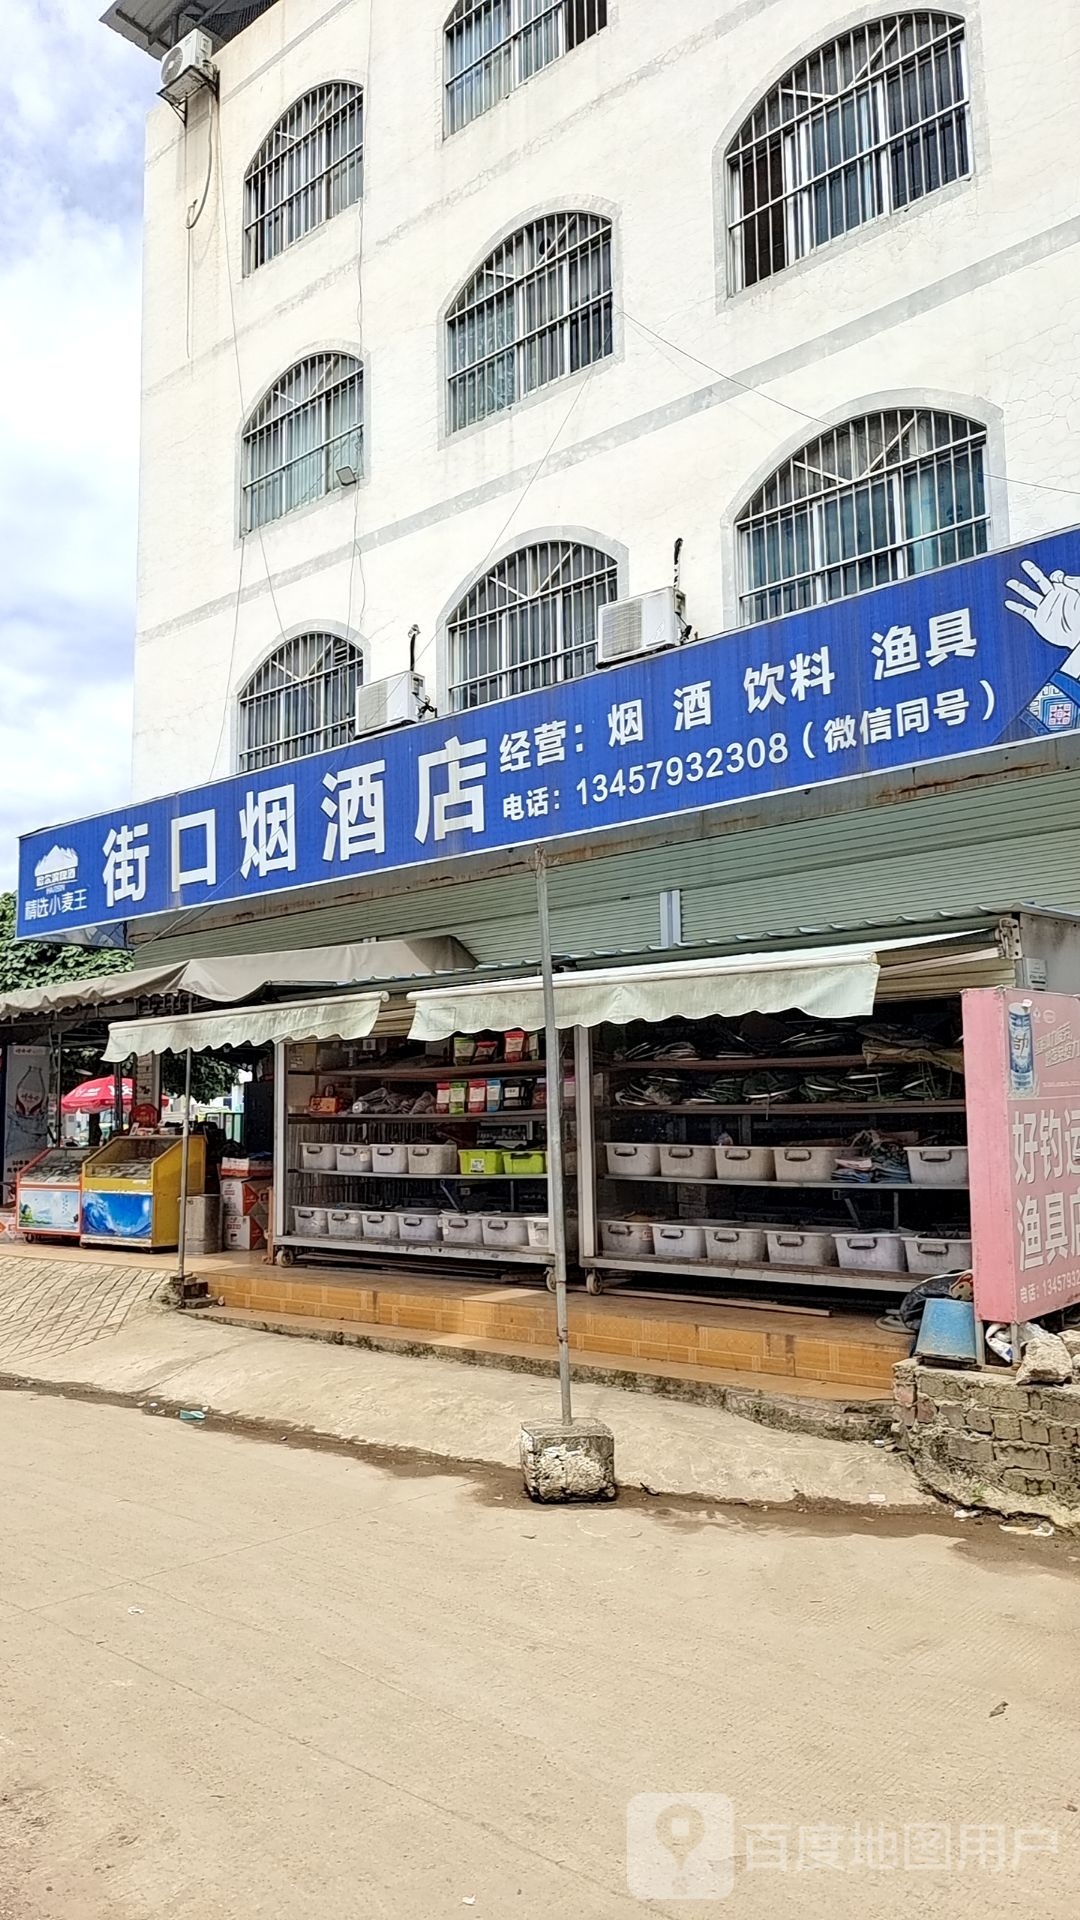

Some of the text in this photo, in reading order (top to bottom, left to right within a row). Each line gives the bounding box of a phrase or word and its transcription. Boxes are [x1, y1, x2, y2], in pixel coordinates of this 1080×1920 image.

[607, 699, 644, 749] 烟
[673, 681, 713, 732] 酒
[743, 646, 836, 714] 饮料
[870, 607, 977, 681] 渔具
[101, 736, 488, 908] 街口烟酒店
[24, 888, 88, 921] 精选小麦王
